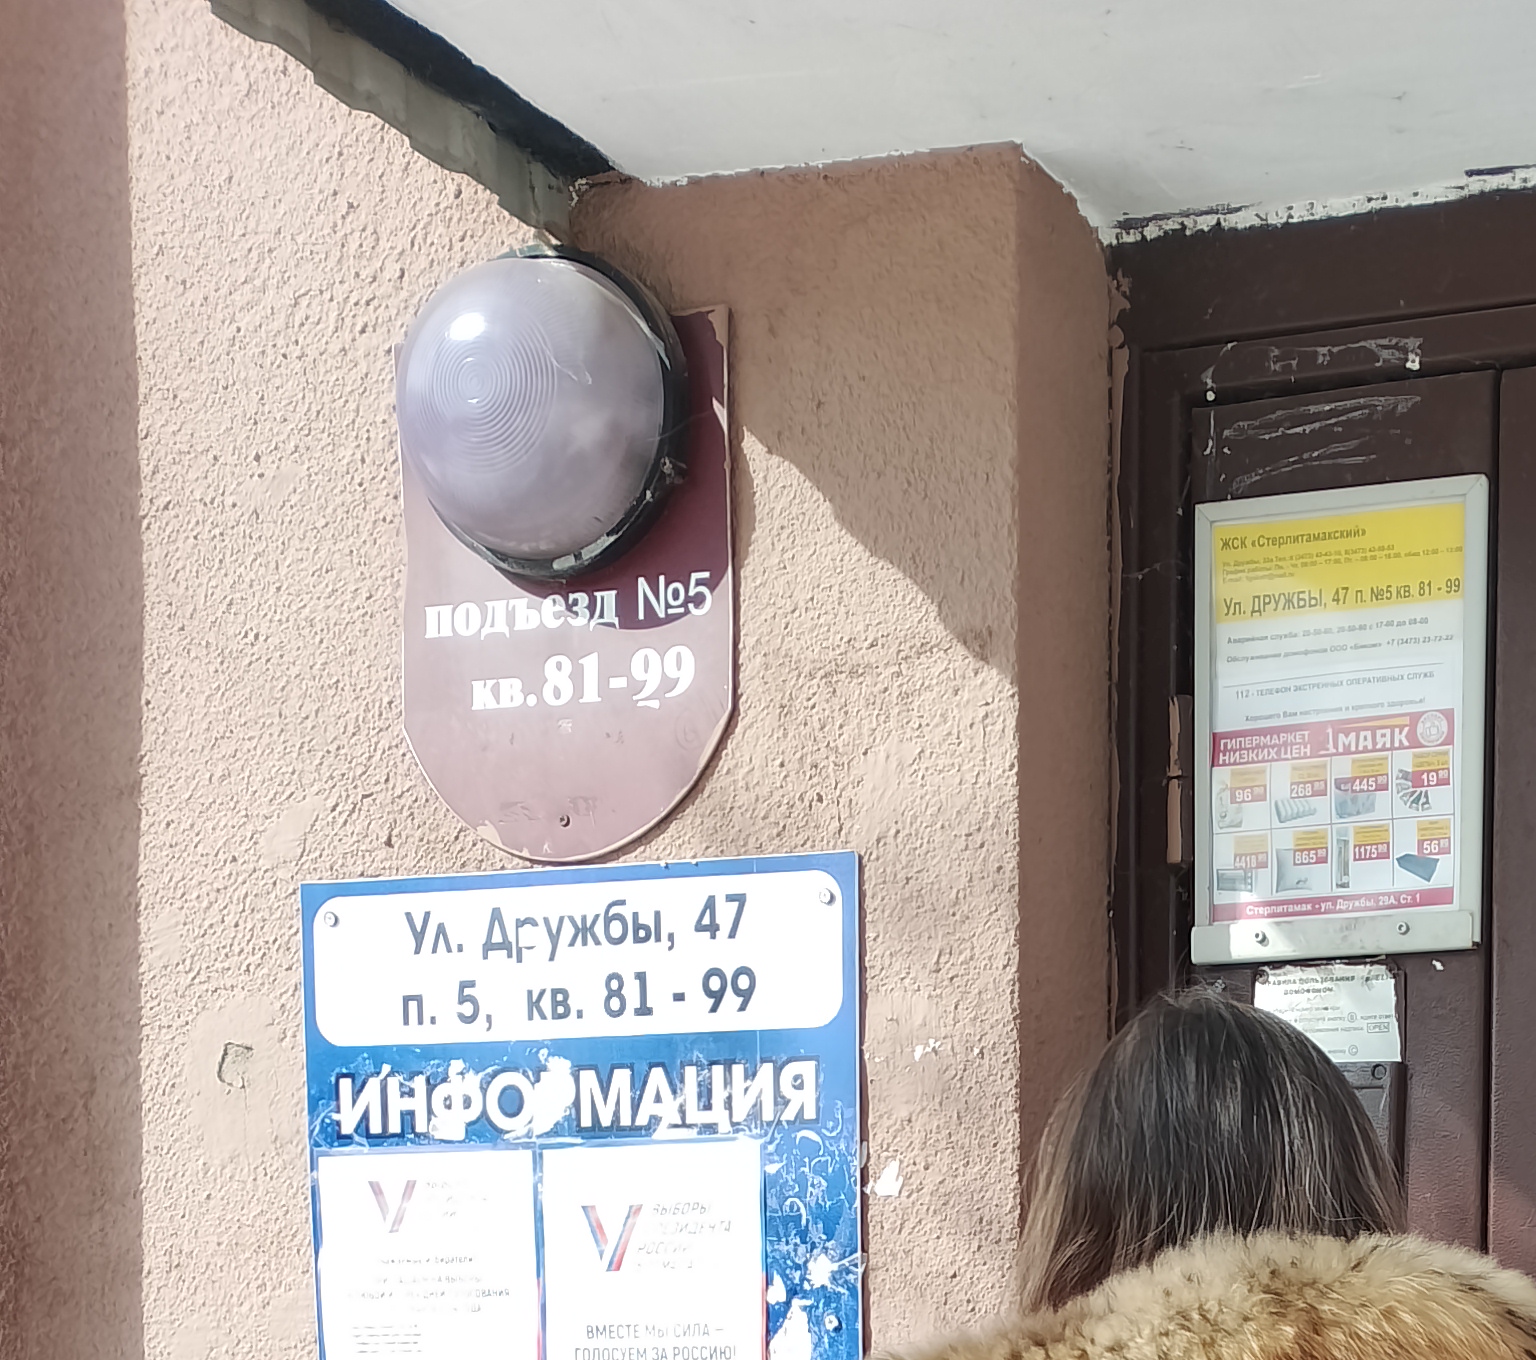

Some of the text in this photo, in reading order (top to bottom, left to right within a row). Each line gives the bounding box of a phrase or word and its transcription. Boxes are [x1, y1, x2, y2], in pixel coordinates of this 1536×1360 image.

[1220, 525, 1367, 551] ЖСК «Стерлитамакский»
[1223, 597, 1246, 616] Ул.
[1251, 588, 1327, 617] ДРУЖБЫ,
[1332, 586, 1349, 605] 47
[1355, 589, 1367, 604] п.
[1370, 585, 1392, 602] №5
[1418, 579, 1432, 597] 81
[1445, 577, 1460, 594] 99
[424, 571, 713, 640] подъезд №5
[1329, 644, 1348, 652] ООО
[1236, 689, 1250, 699] 112
[1256, 686, 1292, 697] ТЕЛЕФОН
[1292, 680, 1344, 692] ЭКСТРЕННЫХ
[1346, 674, 1405, 686] ОПЕРАТИВНЫХ
[1406, 670, 1435, 681] СЛУЖБ
[1220, 730, 1310, 751] ГИПЕРМАРКЕТ
[1338, 726, 1411, 753] МАЯК
[1219, 744, 1311, 764] НИЗКИХ ЦЕН
[1352, 777, 1376, 792] 445
[1421, 771, 1437, 786] 19
[1235, 788, 1252, 802] 96
[1291, 783, 1312, 798] 268
[1354, 845, 1377, 859] 1175
[1423, 840, 1439, 854] 56
[1294, 850, 1316, 864] 865
[1246, 903, 1312, 917] Стерлитамак
[1320, 901, 1334, 912] ул.
[1335, 896, 1377, 911] Дружбы,
[1399, 894, 1413, 905] Ст.
[1416, 893, 1420, 903] 1
[404, 893, 748, 963] Ул. Дружбы, 47
[402, 965, 757, 1032] п. 5, кв. 81 - 99
[1368, 1023, 1389, 1032] OPEN
[653, 1202, 711, 1216] ВЫБОРЫ
[586, 1324, 640, 1340] ВМЕСТЕ
[673, 1322, 711, 1338] СИЛА
[673, 1345, 736, 1360] РОССИЮ!
